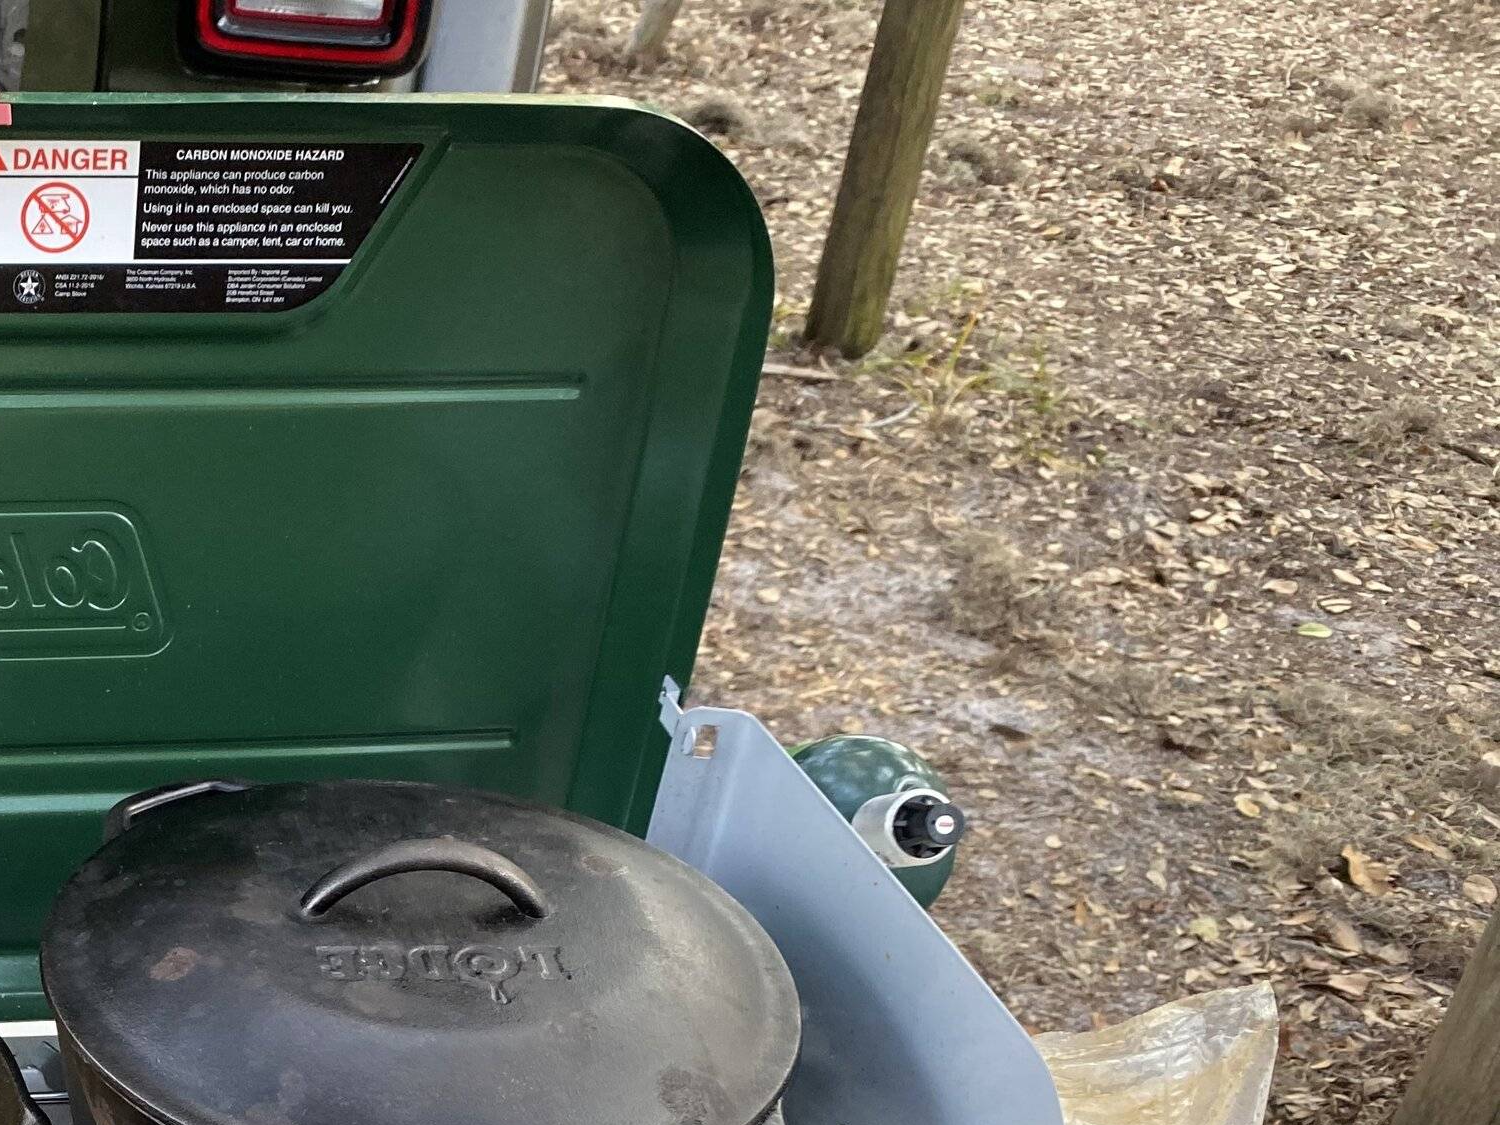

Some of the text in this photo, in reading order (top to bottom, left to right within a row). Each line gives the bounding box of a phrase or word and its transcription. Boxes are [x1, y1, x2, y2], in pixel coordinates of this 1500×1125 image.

[13, 148, 128, 170] DANGER
[176, 149, 344, 161] CARBON MONOXIDE HAZARD
[146, 169, 324, 181] This appliance can produce carbon
[144, 184, 294, 194] monoxide, which has no odor.
[143, 203, 353, 216] Using it in an enclosed space can kill you.
[142, 221, 342, 234] Never use this appliance in an enclosed
[141, 238, 171, 248] space
[173, 236, 197, 246] such
[198, 237, 211, 246] as
[212, 237, 219, 246] a
[221, 238, 260, 247] camper,
[285, 238, 302, 246] car
[303, 238, 314, 246] or
[315, 237, 345, 246] home.
